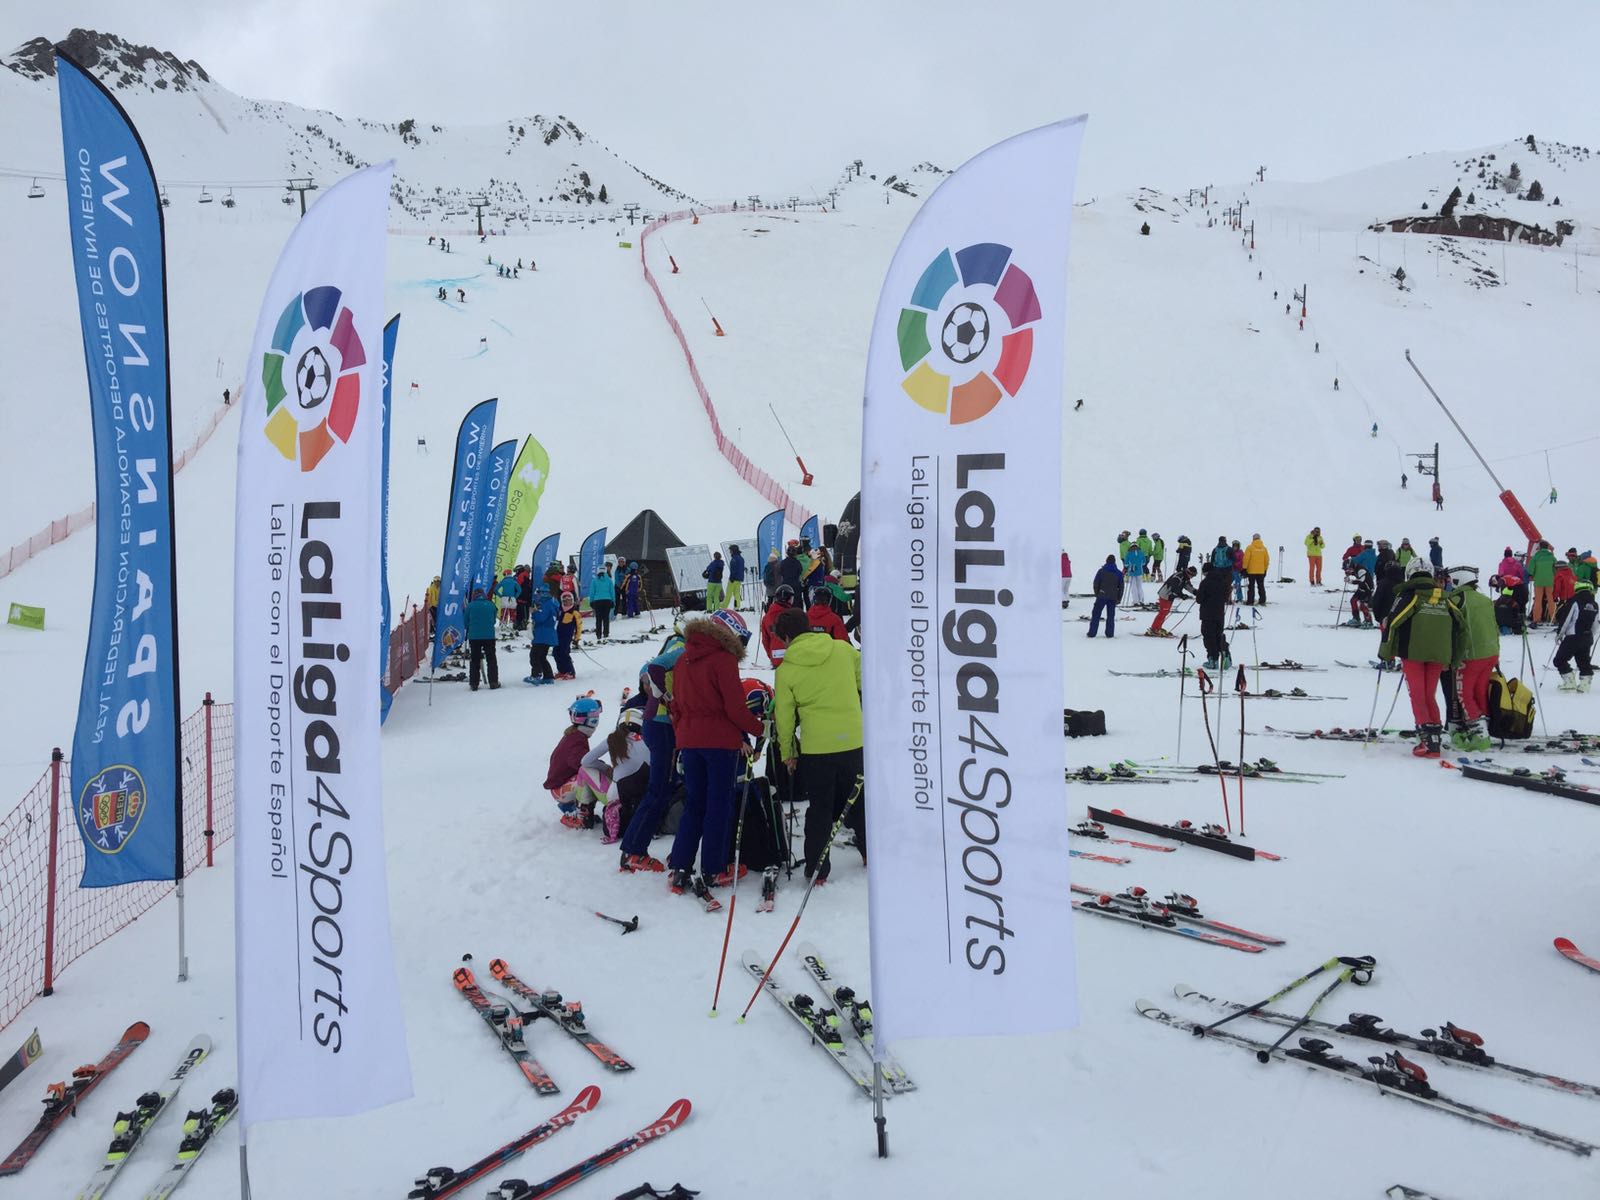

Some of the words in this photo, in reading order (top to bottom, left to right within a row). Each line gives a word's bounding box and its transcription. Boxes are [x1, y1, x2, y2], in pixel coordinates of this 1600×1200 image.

[906, 456, 929, 530] LaLiga
[267, 503, 286, 581] LaLiga
[911, 538, 924, 581] con
[270, 590, 281, 635] con
[911, 590, 928, 609] el
[271, 645, 283, 664] el
[907, 619, 929, 712] Deporte
[267, 676, 286, 773] Deporte
[942, 453, 1014, 975] LaLiga4Sports
[293, 502, 352, 1053] LaLiga4Sports
[908, 722, 934, 811] Español
[267, 783, 288, 878] Español
[750, 964, 779, 989] HD
[805, 956, 832, 981] HEAD
[170, 1048, 204, 1081] HEAD
